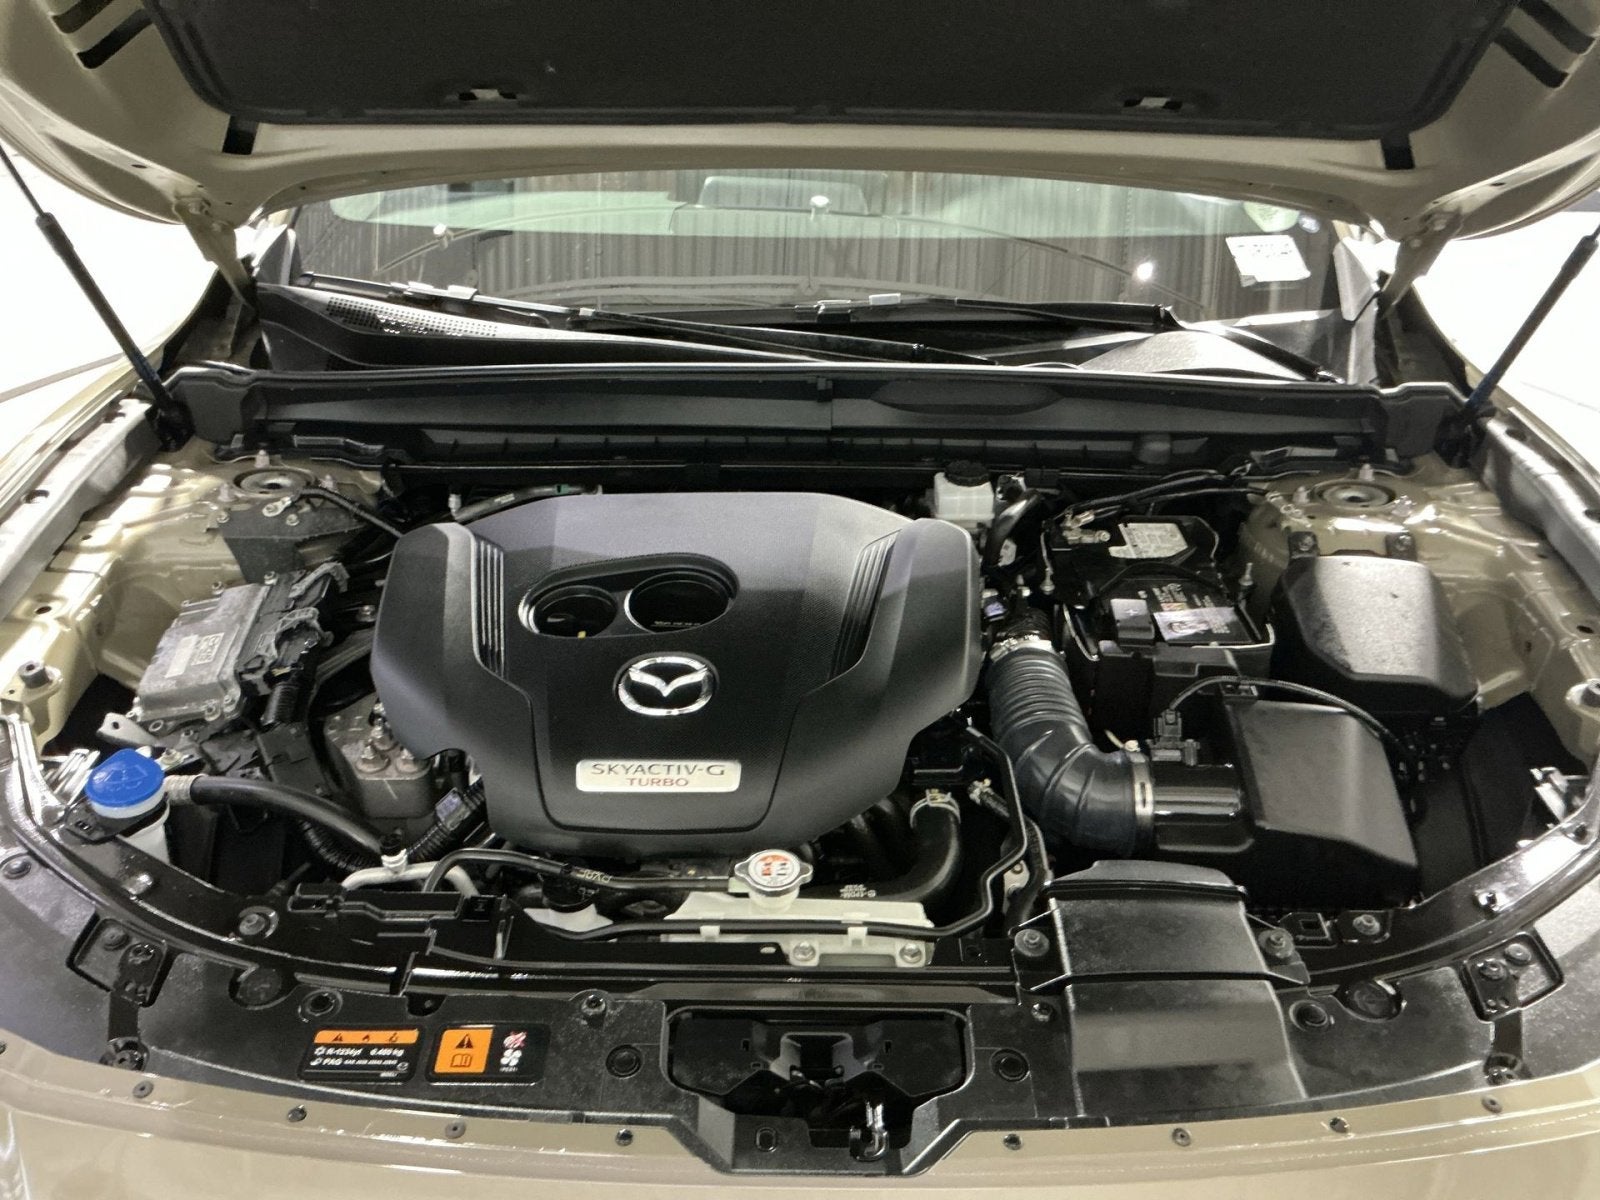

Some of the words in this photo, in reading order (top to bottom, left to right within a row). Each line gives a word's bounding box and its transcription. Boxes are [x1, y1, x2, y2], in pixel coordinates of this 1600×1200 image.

[591, 763, 726, 776] SKYACTIV-G
[626, 777, 689, 787] TURBO
[322, 1058, 342, 1066] PAG
